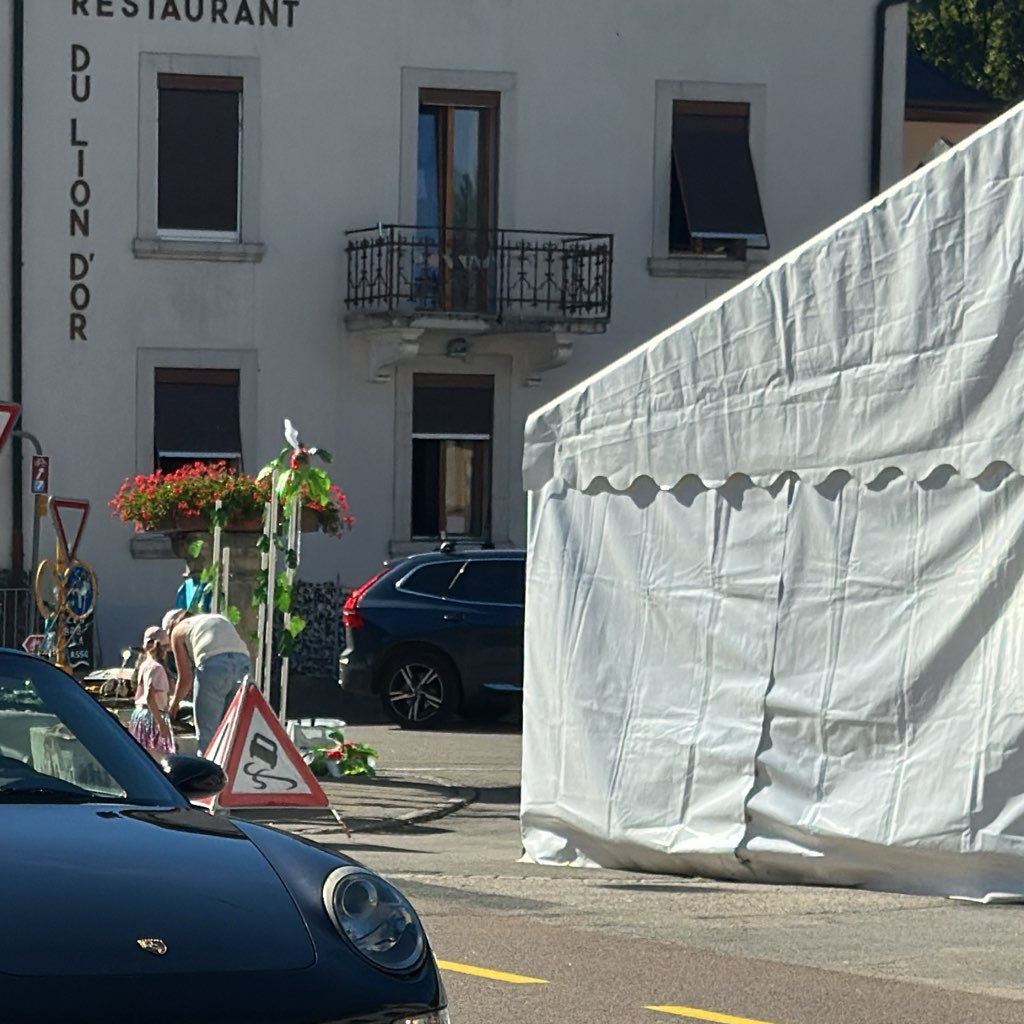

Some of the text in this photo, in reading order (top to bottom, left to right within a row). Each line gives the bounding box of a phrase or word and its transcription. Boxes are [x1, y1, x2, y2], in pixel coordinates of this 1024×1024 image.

[71, 0, 300, 28] RESTAURANT
[70, 44, 95, 341] DU LION D'OR
